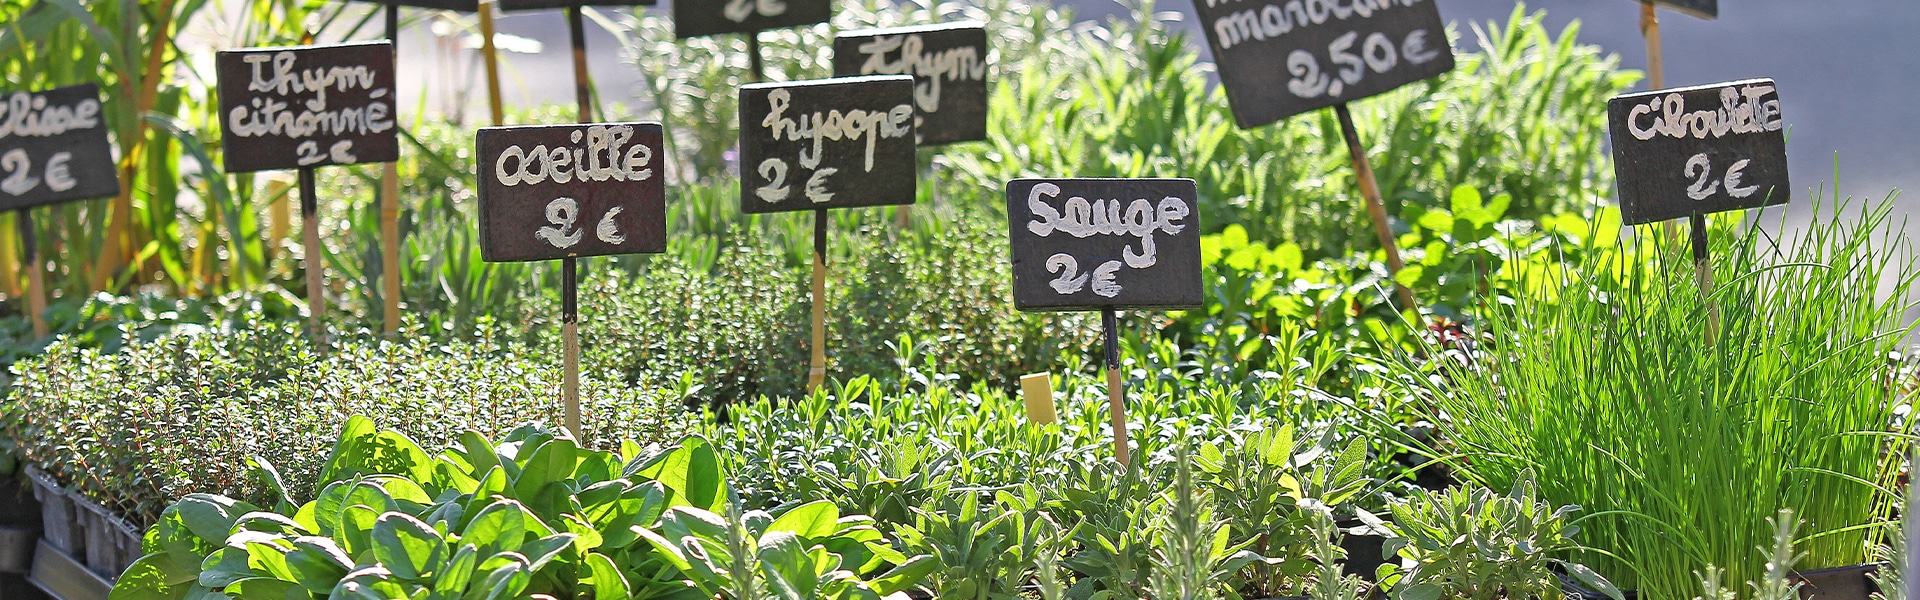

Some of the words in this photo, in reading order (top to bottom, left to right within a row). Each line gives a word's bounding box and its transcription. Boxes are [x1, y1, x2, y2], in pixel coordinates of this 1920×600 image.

[229, 88, 394, 139] citronné
[762, 88, 913, 172] hysope
[496, 125, 653, 186] oseille
[1027, 182, 1190, 269] Sauge
